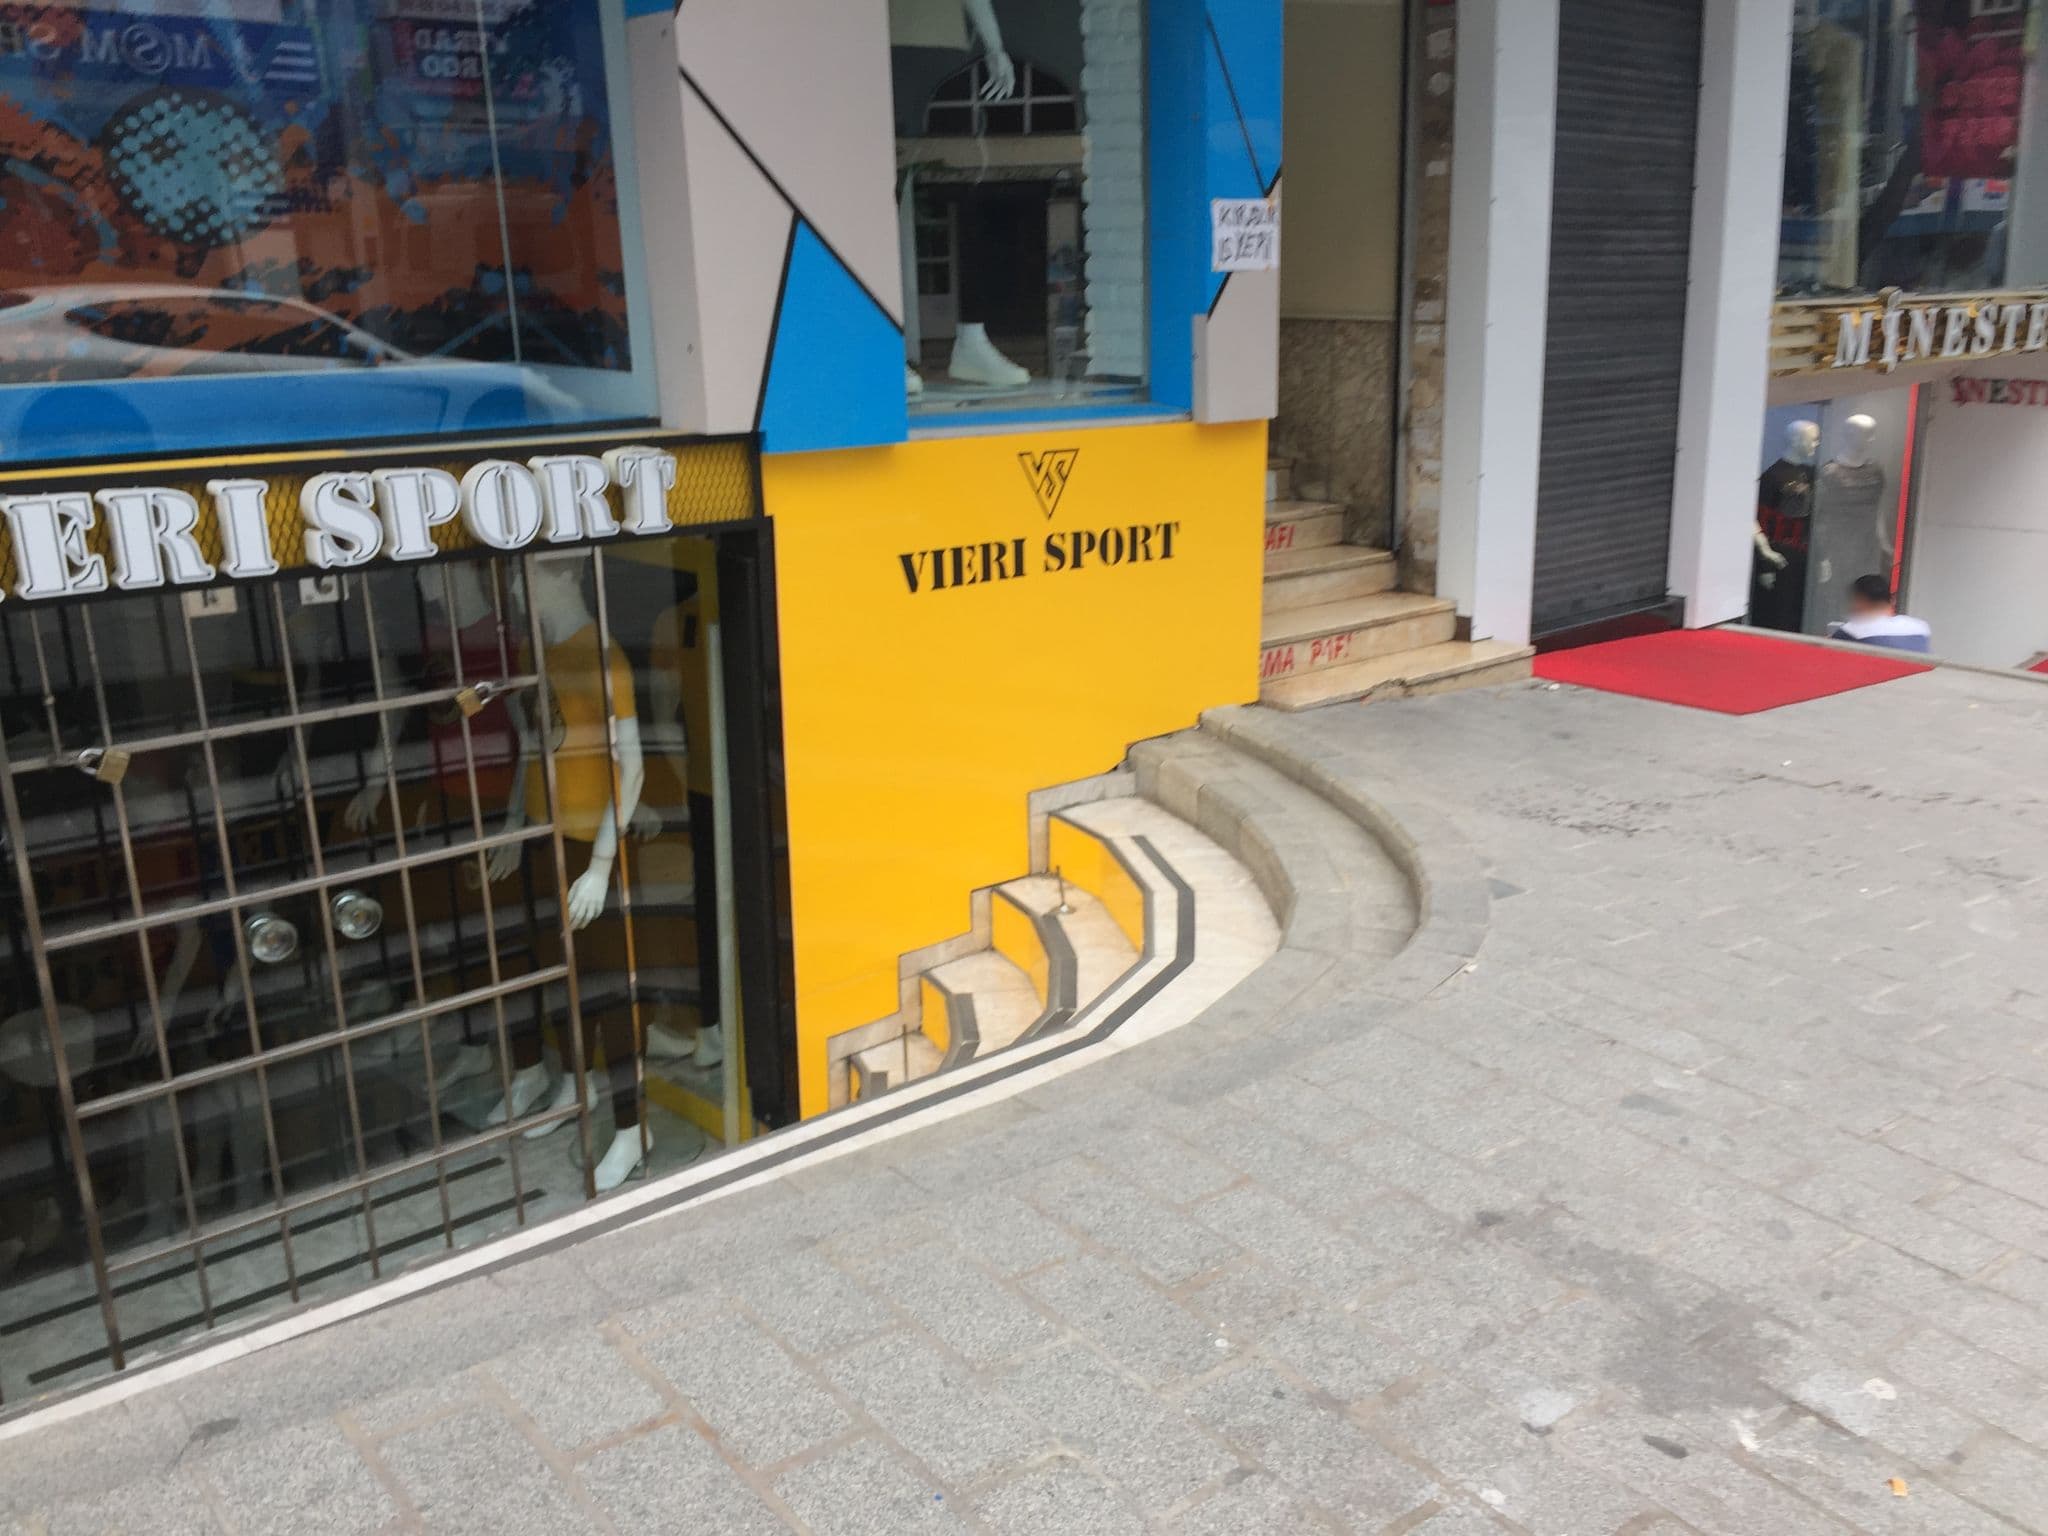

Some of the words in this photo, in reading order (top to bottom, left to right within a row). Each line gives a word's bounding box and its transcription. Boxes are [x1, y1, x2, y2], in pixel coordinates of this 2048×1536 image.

[0, 478, 279, 603] ERI
[300, 445, 678, 569] SPORT
[898, 538, 1028, 594] VIERI
[1044, 521, 1181, 573] SPORT
[1264, 524, 1296, 551] AFI
